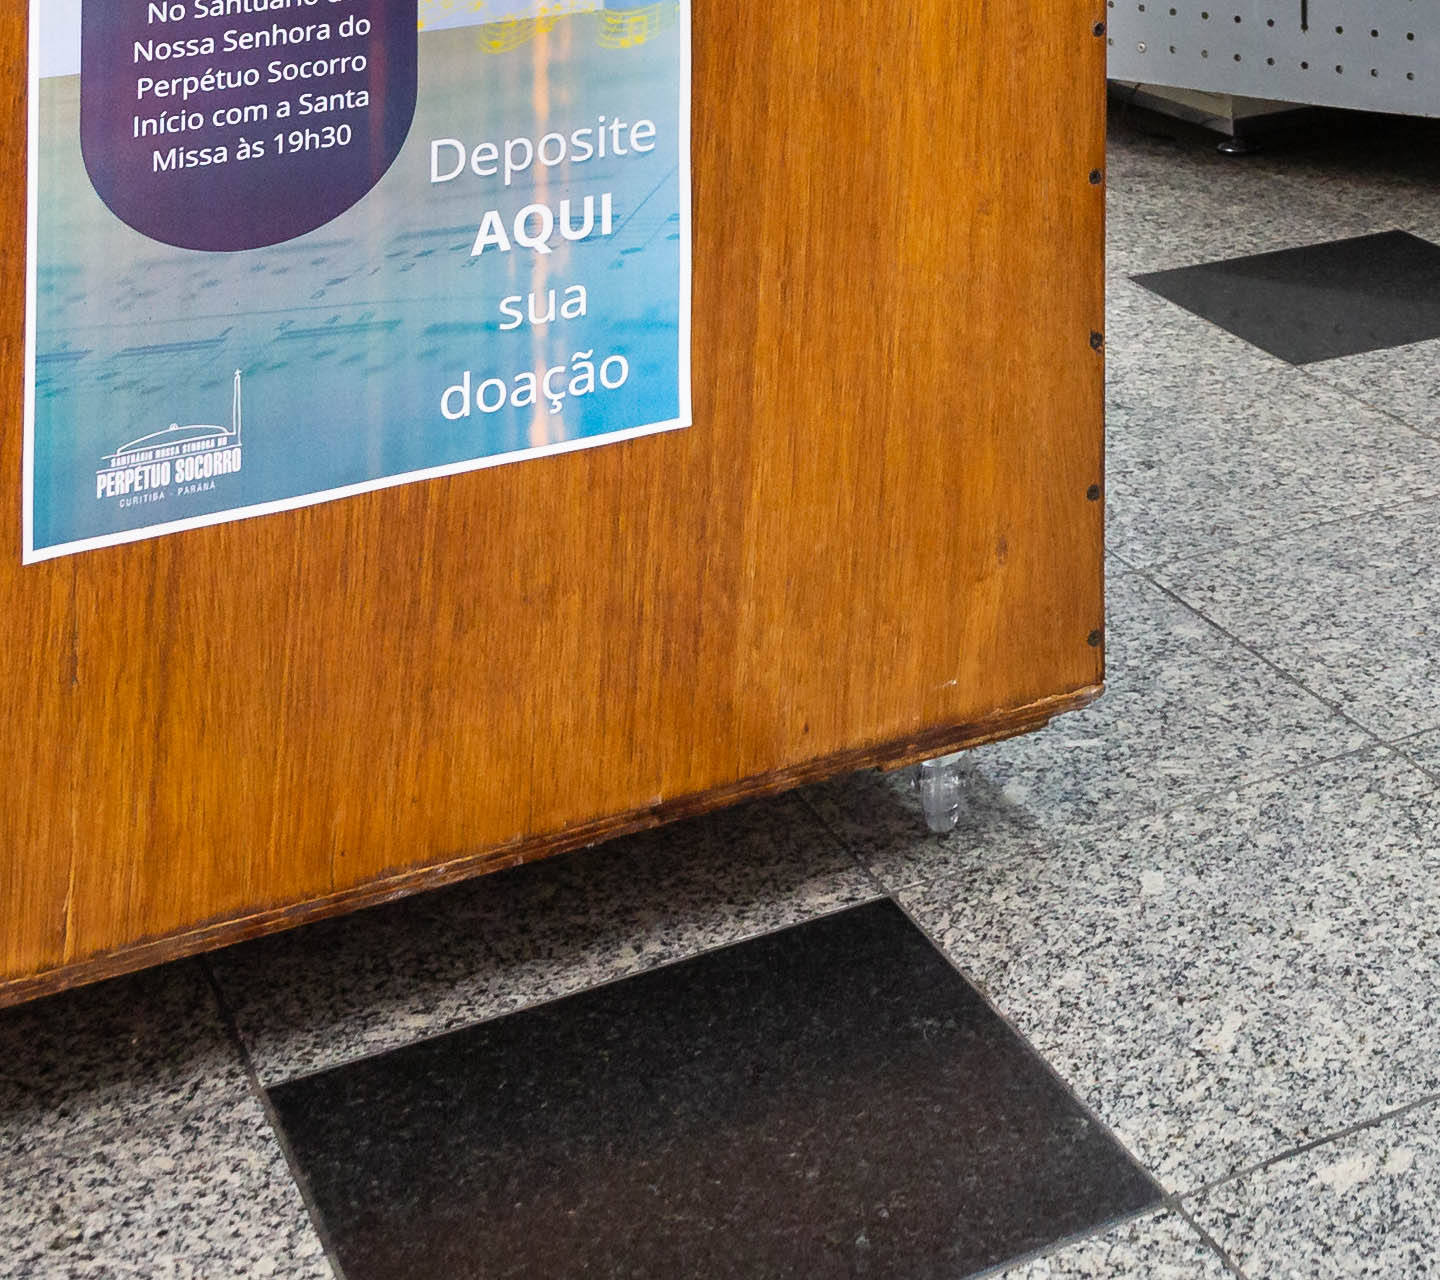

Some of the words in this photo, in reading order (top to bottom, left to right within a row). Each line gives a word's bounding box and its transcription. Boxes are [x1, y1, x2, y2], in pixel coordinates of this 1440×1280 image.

[133, 33, 216, 64] Nossa
[223, 19, 333, 56] Senhora
[338, 15, 371, 41] do
[136, 63, 260, 100] Perpétuo
[267, 53, 368, 83] Socorro
[133, 106, 204, 138] Início
[212, 103, 267, 128] com
[275, 101, 291, 119] a
[298, 87, 371, 116] Santa
[153, 143, 228, 173] Missa
[235, 133, 265, 161] às
[272, 124, 352, 156] 19h30
[429, 117, 657, 186] Deposite
[470, 192, 613, 257] AQUI
[498, 284, 588, 331] sua
[440, 350, 629, 421] doação
[96, 461, 171, 500] PERPÉTUO
[175, 447, 242, 483] SOCORRO
[119, 491, 165, 508] CURITIBA
[177, 481, 216, 496] PARANÁ
